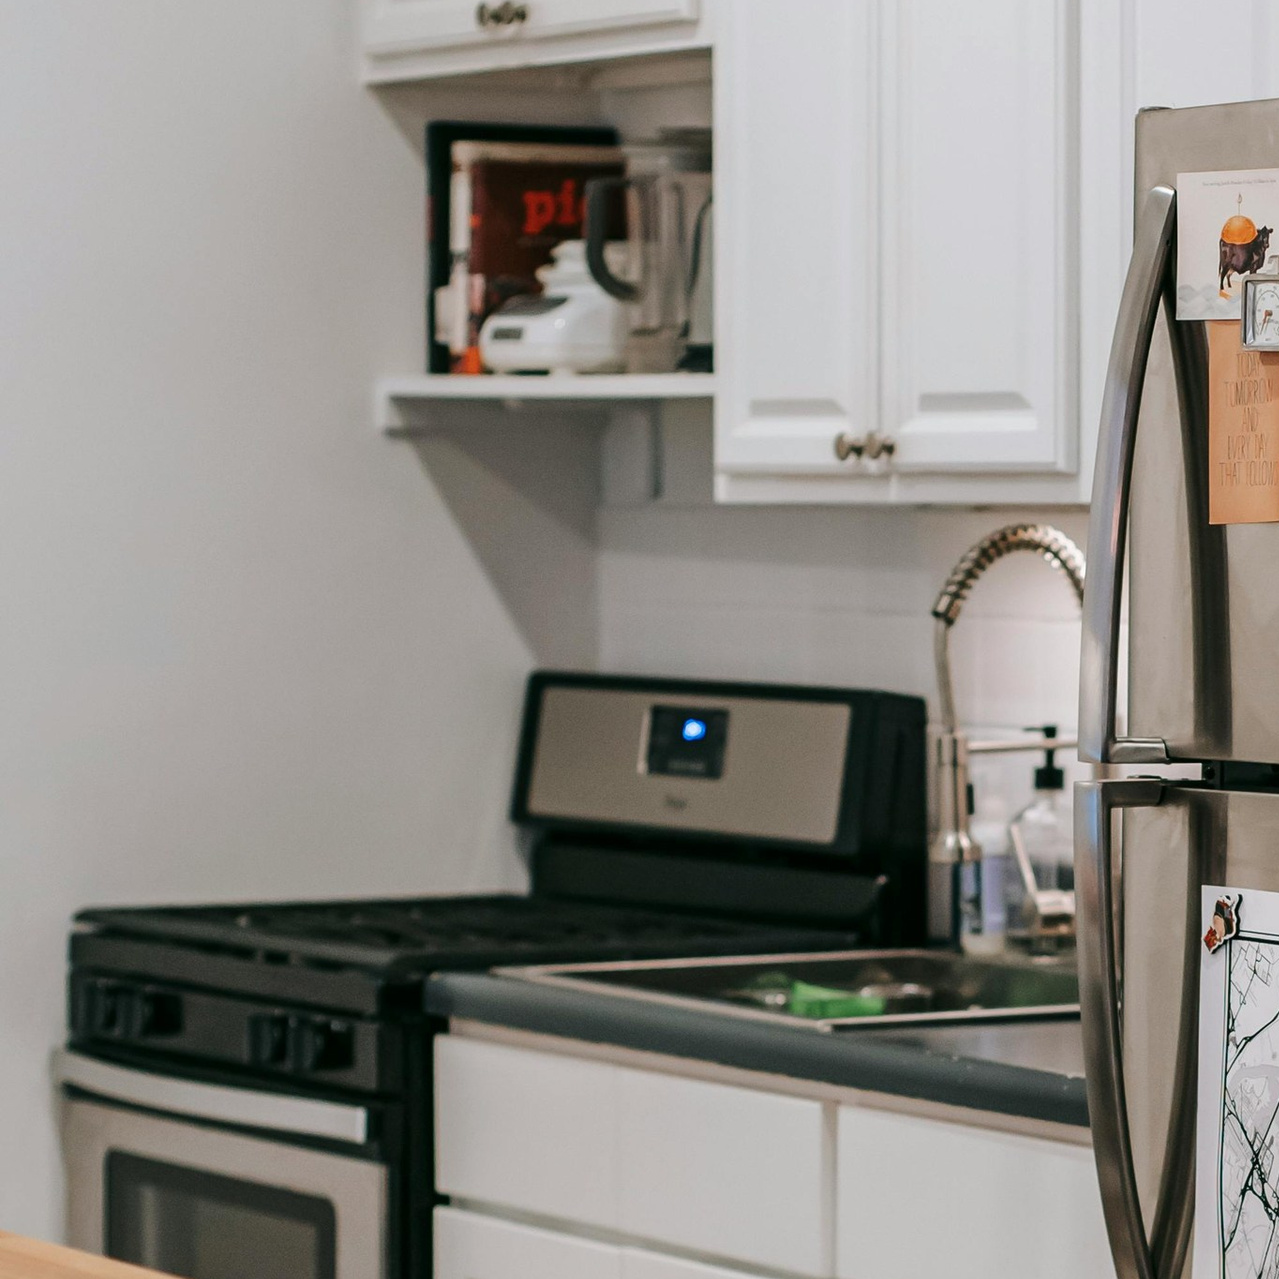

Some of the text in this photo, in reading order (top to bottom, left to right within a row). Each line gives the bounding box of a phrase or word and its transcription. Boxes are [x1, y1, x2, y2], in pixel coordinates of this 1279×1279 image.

[1236, 352, 1261, 378] TODAY
[1223, 378, 1274, 408] TOMORROW
[1242, 406, 1260, 433] AND
[1227, 432, 1269, 460] EVERY DAY
[1218, 460, 1279, 487] THAT FOLLOWS
